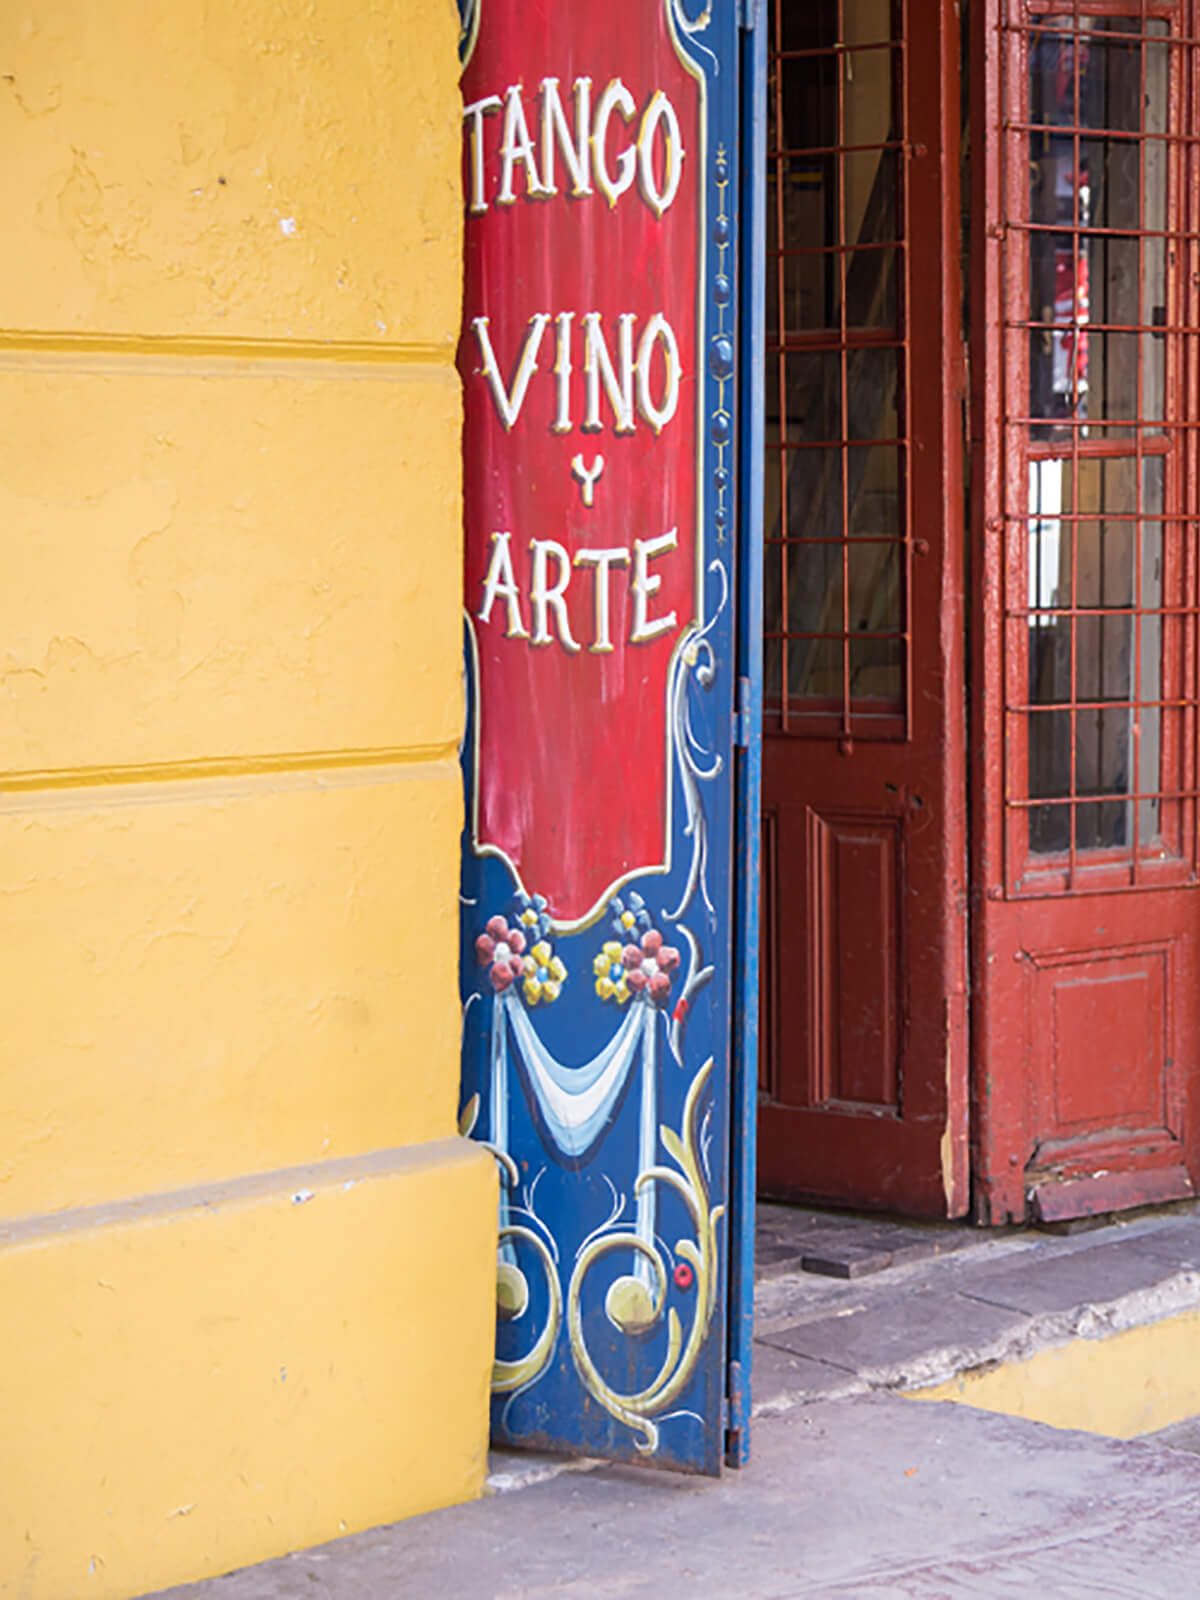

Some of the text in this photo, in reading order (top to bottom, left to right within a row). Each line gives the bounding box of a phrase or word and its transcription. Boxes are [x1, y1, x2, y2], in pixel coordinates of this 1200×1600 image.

[463, 77, 685, 216] TANGO
[472, 312, 684, 436] VINO
[572, 453, 604, 506] Y
[478, 527, 678, 655] ARTE
